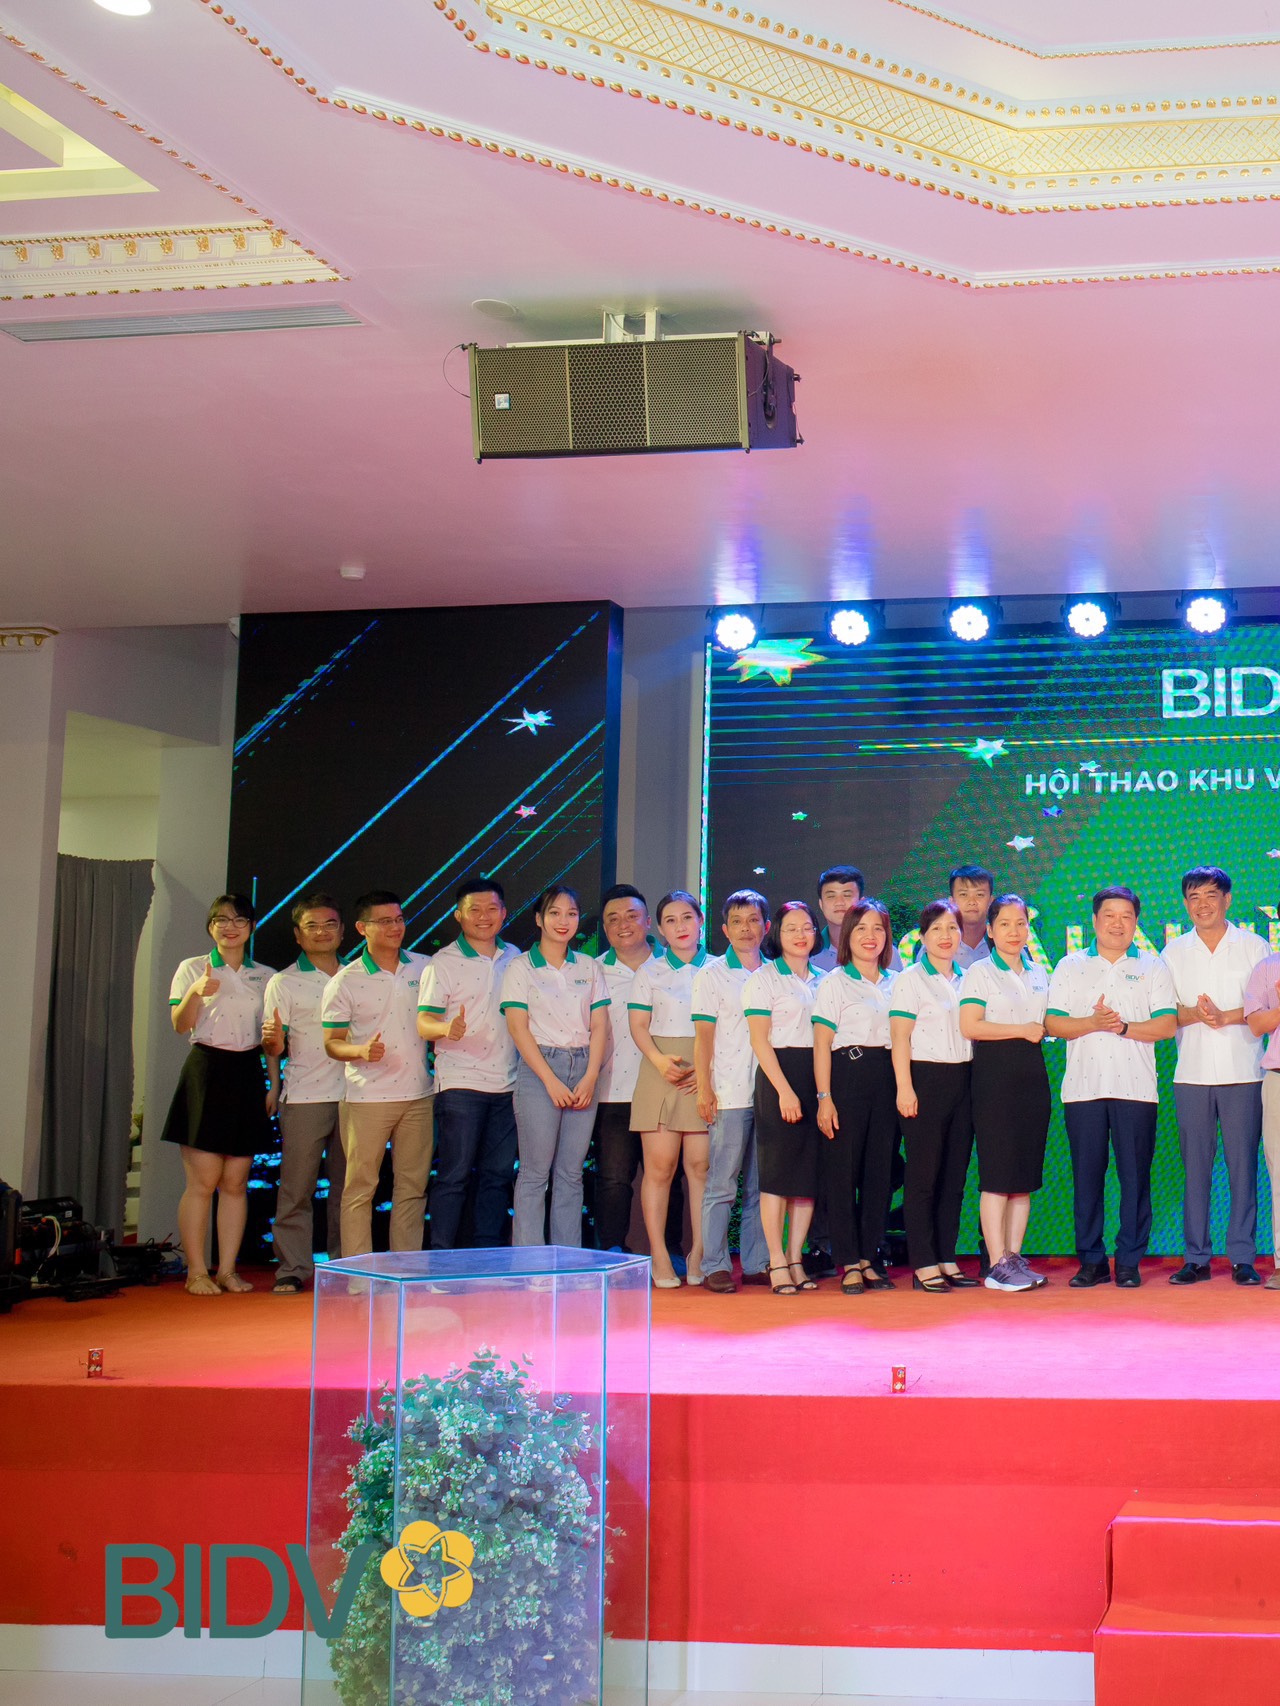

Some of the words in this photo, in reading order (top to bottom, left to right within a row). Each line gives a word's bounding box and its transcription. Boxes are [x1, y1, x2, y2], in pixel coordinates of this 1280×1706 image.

[1025, 768, 1079, 799] HỘI
[1088, 769, 1179, 795] THAO
[1188, 767, 1255, 792] KHU
